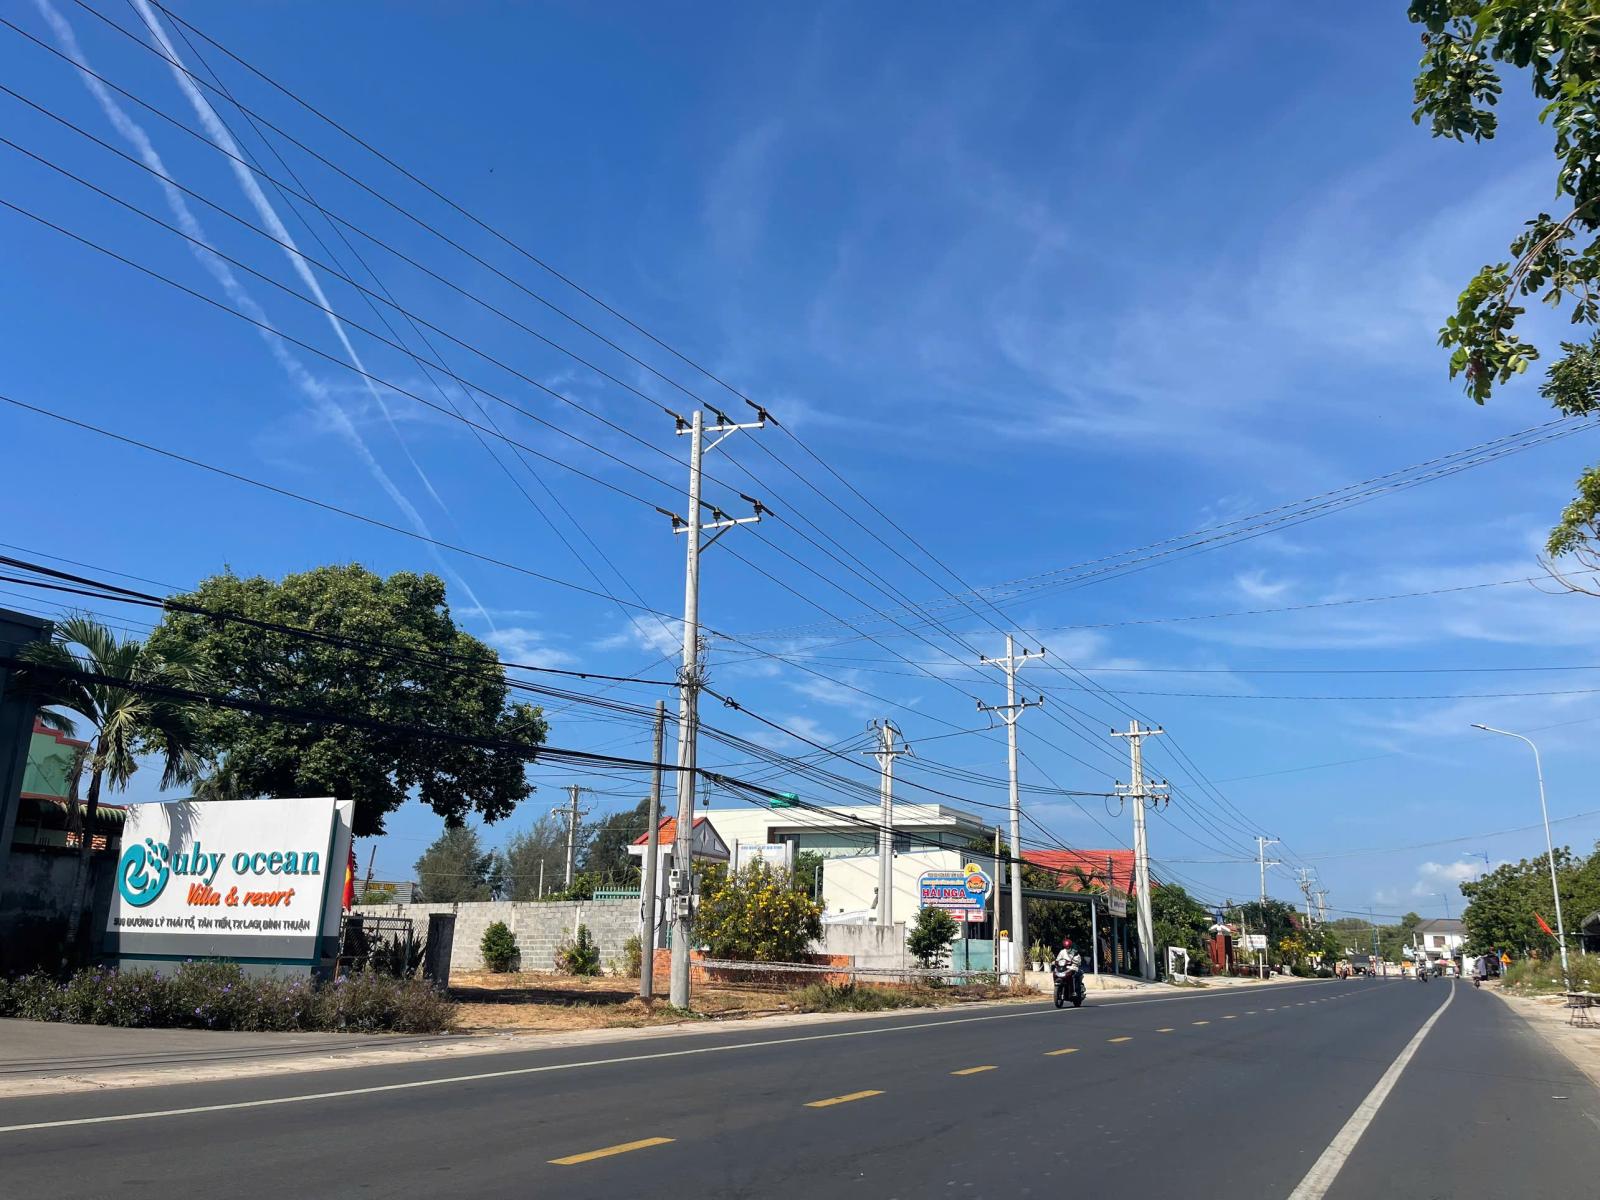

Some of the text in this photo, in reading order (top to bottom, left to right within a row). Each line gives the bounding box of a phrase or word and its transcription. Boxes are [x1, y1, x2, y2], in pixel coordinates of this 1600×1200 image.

[232, 850, 320, 876] ocean
[187, 882, 295, 907] Villa & resort
[943, 888, 966, 897] NGA
